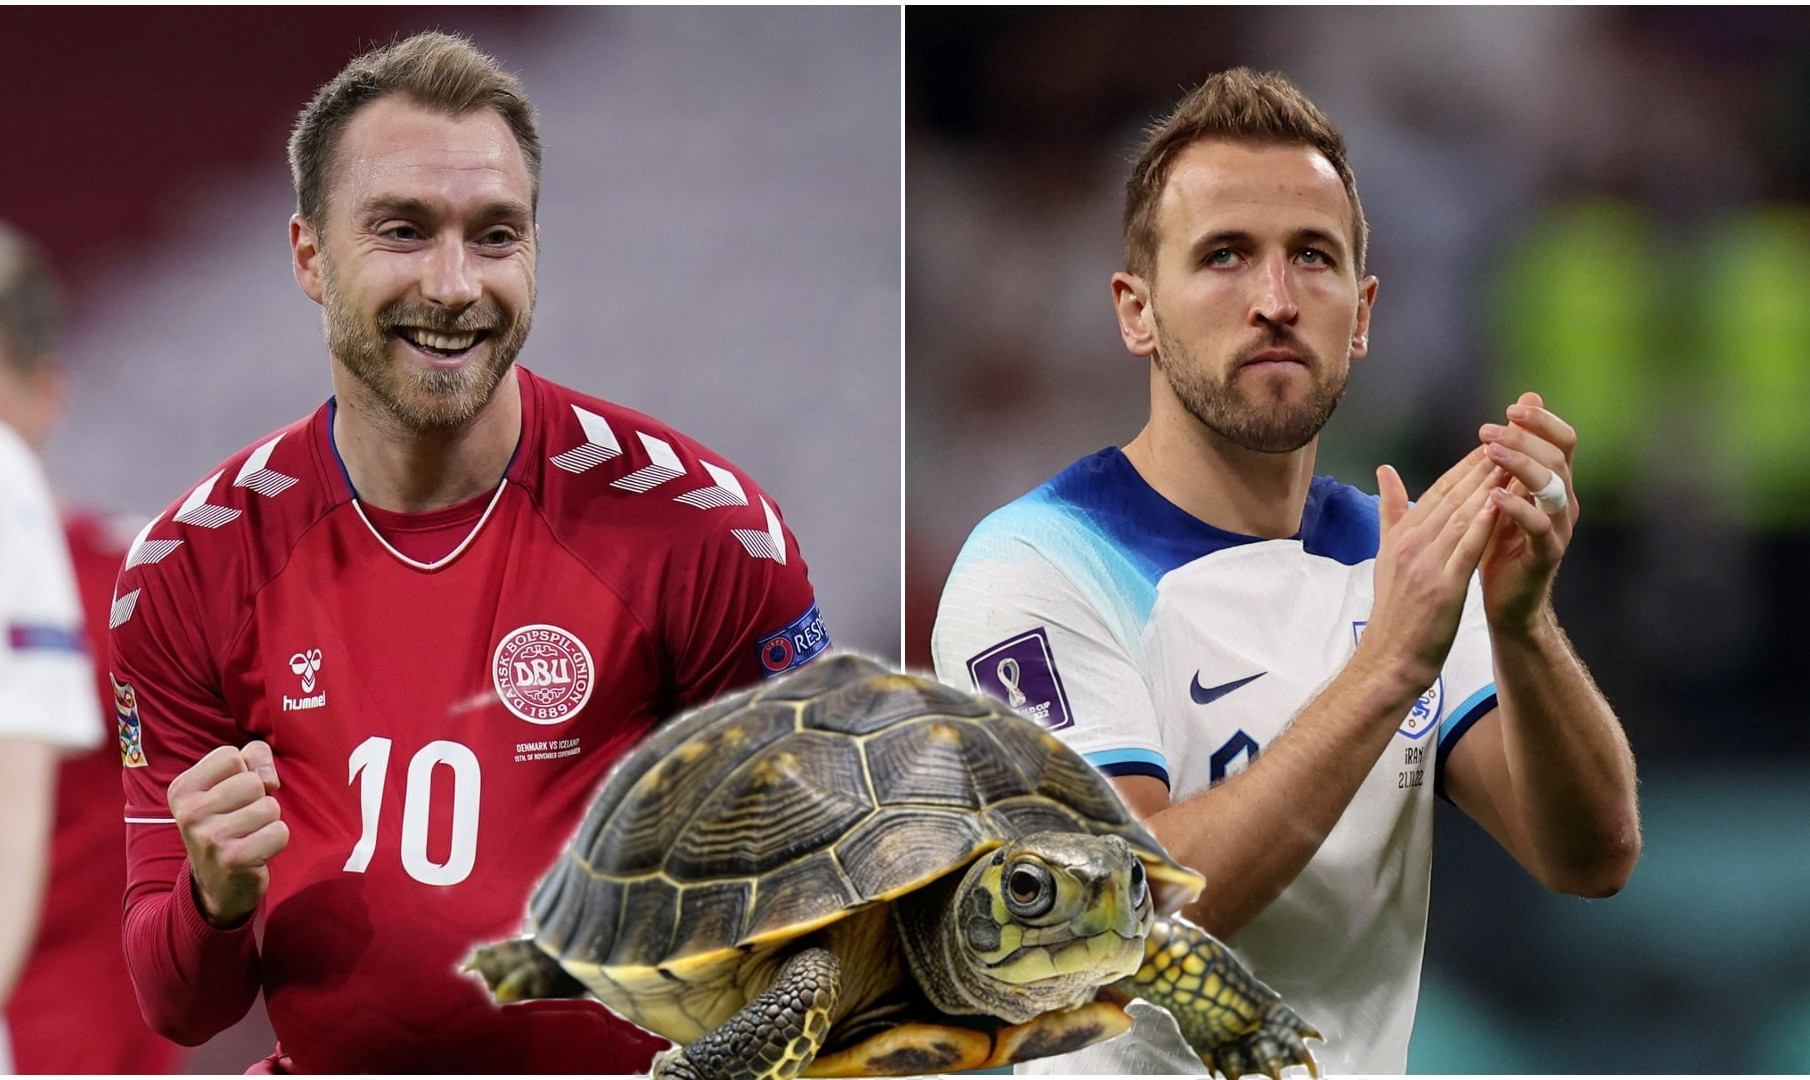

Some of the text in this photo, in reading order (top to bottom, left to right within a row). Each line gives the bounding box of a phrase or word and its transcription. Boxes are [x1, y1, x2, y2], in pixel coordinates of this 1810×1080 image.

[513, 658, 572, 687] DBU
[498, 655, 526, 711] DANSK
[283, 690, 326, 711] hummel
[1035, 701, 1051, 711] CUP
[529, 702, 568, 719] 1889
[516, 738, 580, 753] DENMARK VS ICELAND
[527, 753, 534, 761] OF
[534, 751, 557, 760] NOVEMBER
[342, 736, 482, 886] 10
